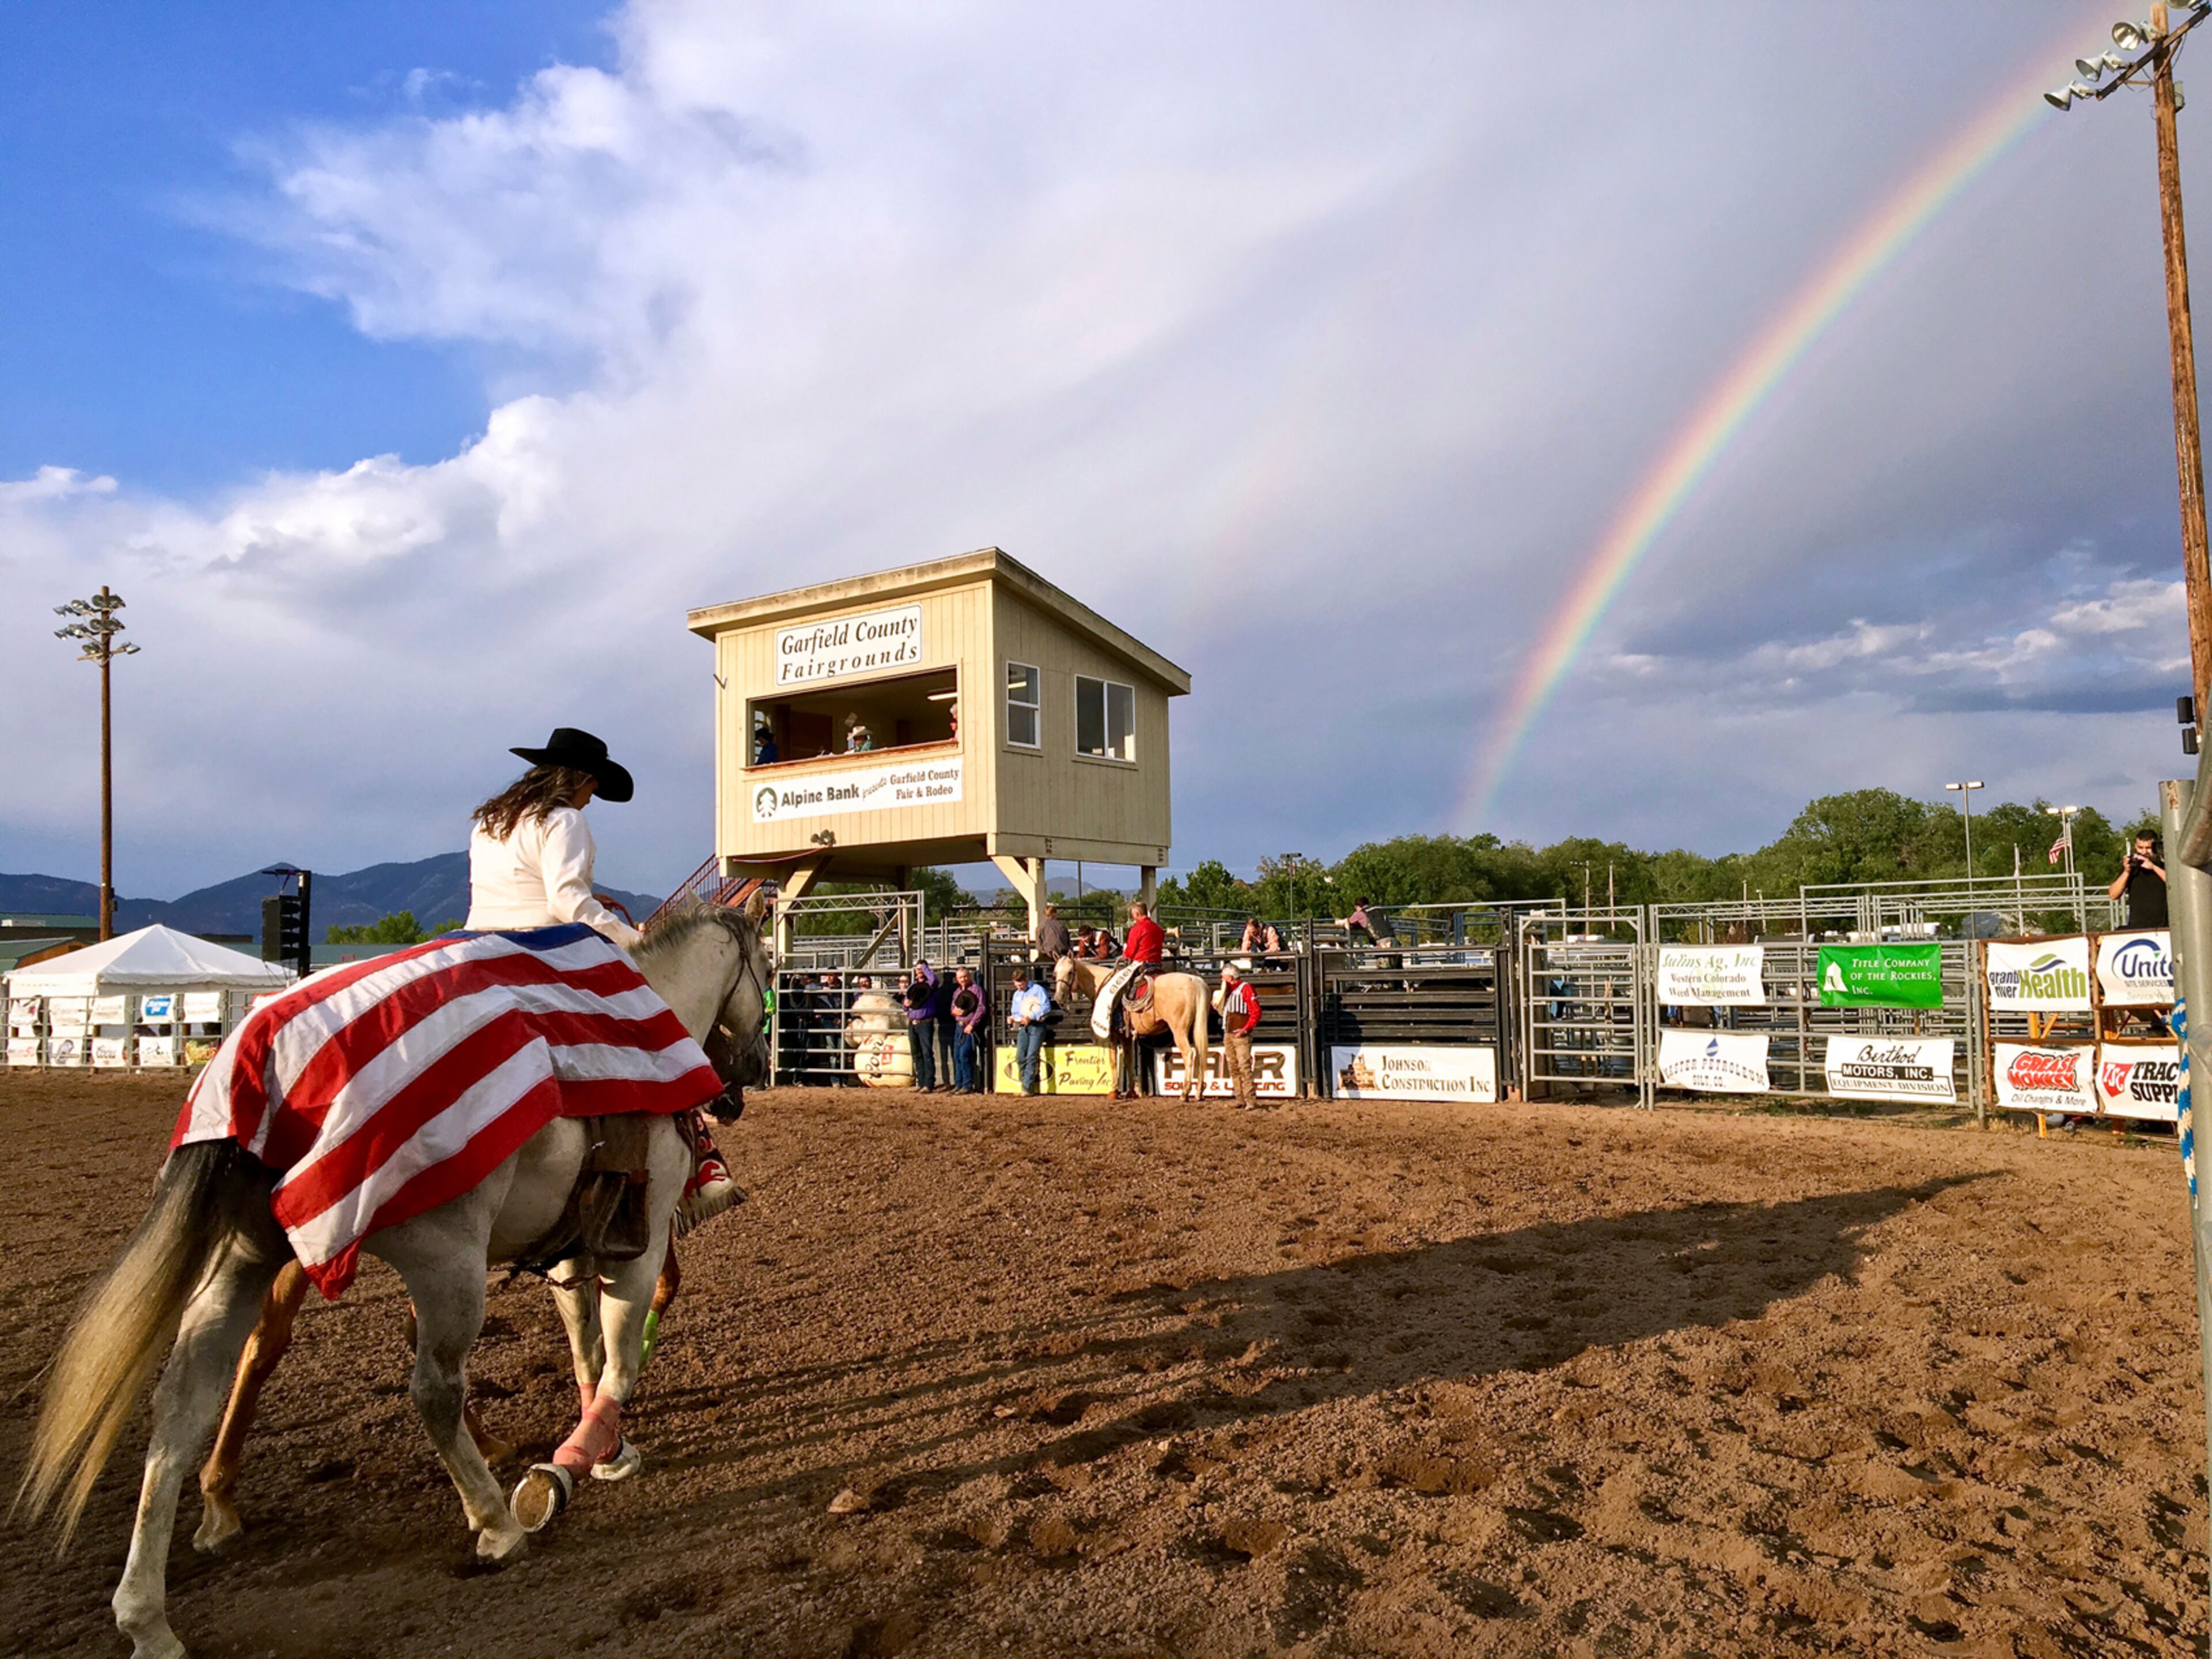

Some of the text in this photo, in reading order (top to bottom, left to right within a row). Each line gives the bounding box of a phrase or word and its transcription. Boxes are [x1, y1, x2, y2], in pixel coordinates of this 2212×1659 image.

[782, 616, 918, 655] Garfield County
[782, 642, 918, 680] Fairgrounds
[781, 789, 823, 808] Alpine
[827, 783, 859, 801] Bank
[890, 771, 926, 785] Garfield
[928, 768, 959, 781] County
[896, 785, 953, 800] Fair & Rodeo
[1671, 972, 1747, 983] Western Colorado
[2018, 967, 2086, 999] Health
[1691, 987, 1751, 998] Management
[1994, 985, 2018, 998] river
[1065, 1050, 1105, 1066] Frontier
[1857, 1044, 1922, 1064] Berthod
[2015, 1054, 2080, 1073] GREASE
[1059, 1071, 1094, 1090] Paving
[1702, 1058, 1765, 1086] PETROLEUM
[1843, 1065, 1933, 1080] MOTORS, INC.
[2009, 1070, 2078, 1090] MONKEY
[2103, 1064, 2126, 1092] TSC
[1164, 1081, 1286, 1091] SON & LING
[1832, 1078, 1949, 1093] EQUIPMENT DIVISION
[2011, 1093, 2086, 1106] Oil Changes & More
